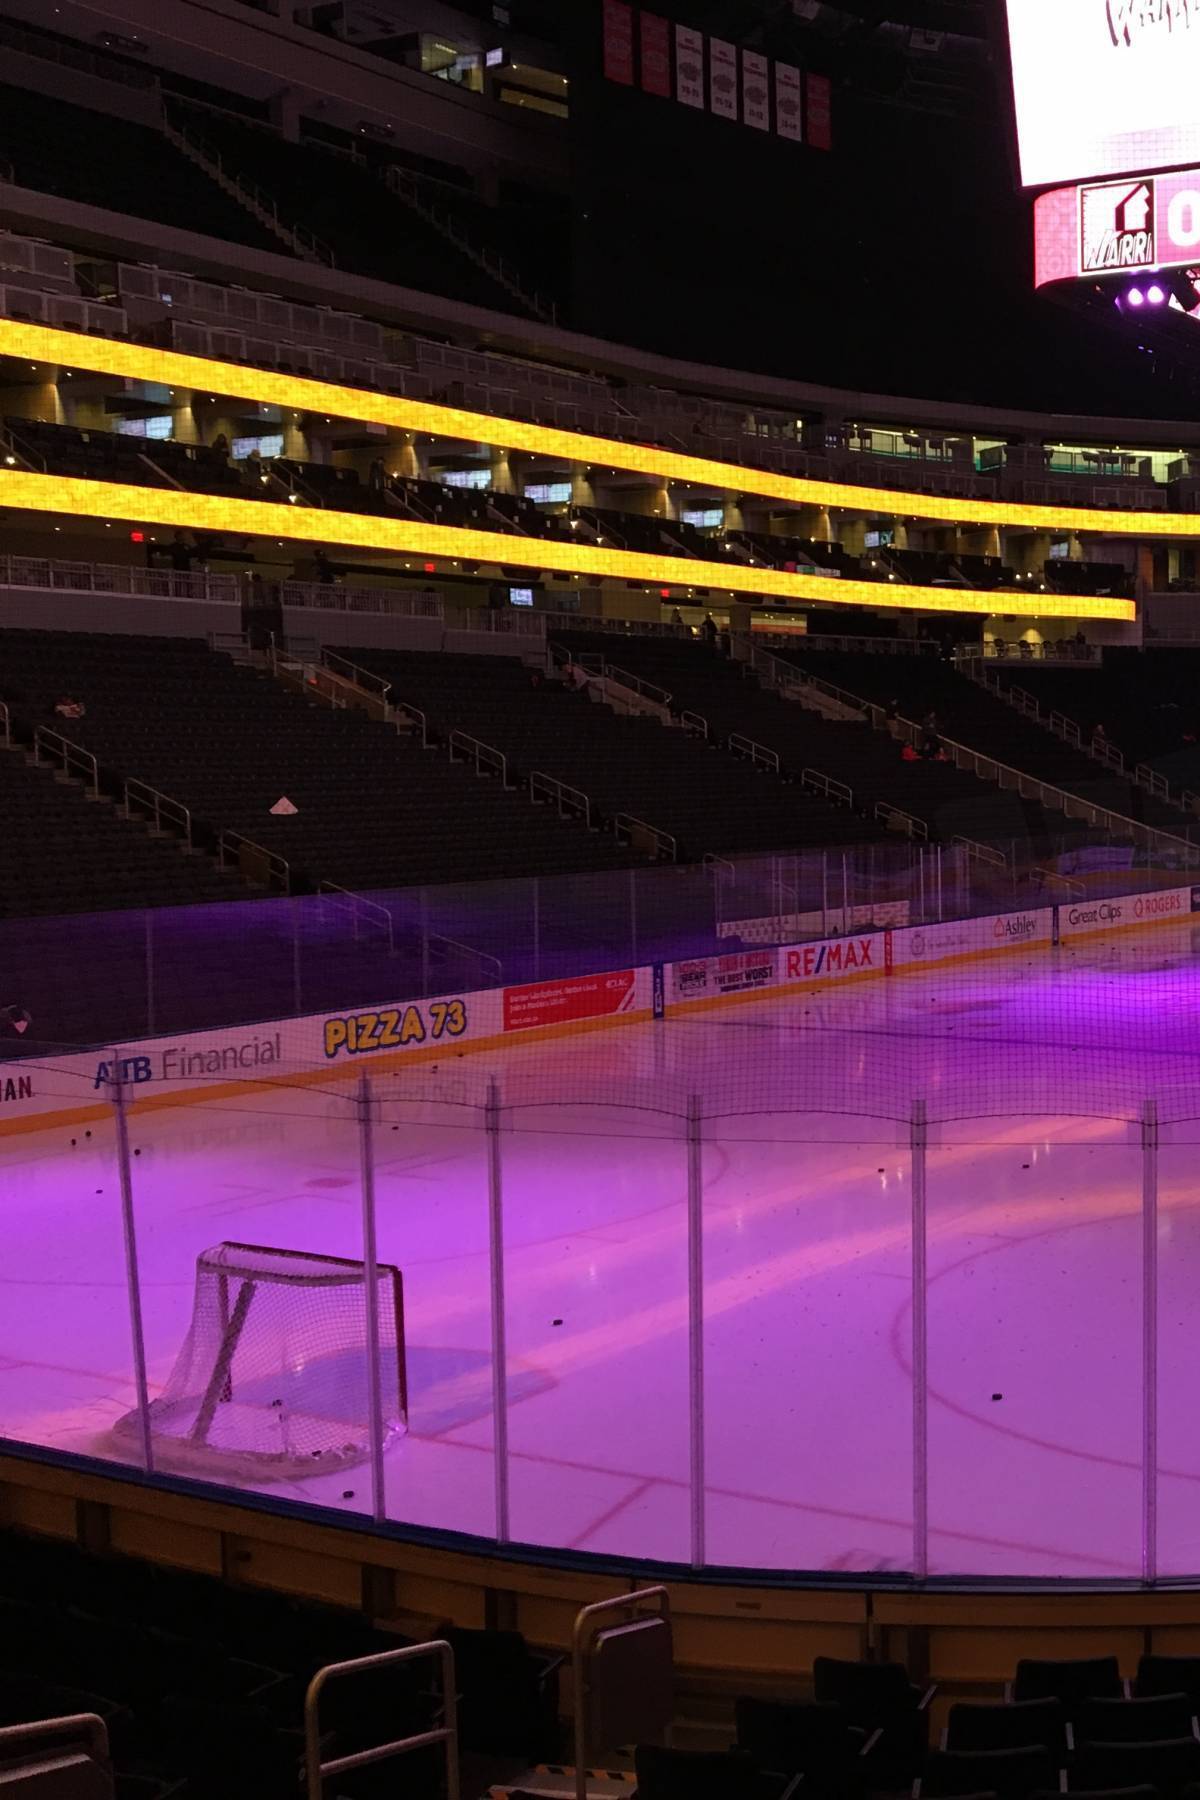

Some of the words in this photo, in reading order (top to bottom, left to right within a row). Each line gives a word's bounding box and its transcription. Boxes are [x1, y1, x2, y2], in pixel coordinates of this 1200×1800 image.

[1069, 907, 1097, 926] Great
[1099, 903, 1122, 922] Clips
[1145, 894, 1181, 914] ROGERS
[1006, 919, 1037, 937] Ashley
[786, 939, 873, 978] RE/MAX
[745, 966, 773, 981] WORST
[325, 1006, 427, 1058] PIZZA
[429, 1000, 468, 1036] 73
[161, 1033, 281, 1080] Financial
